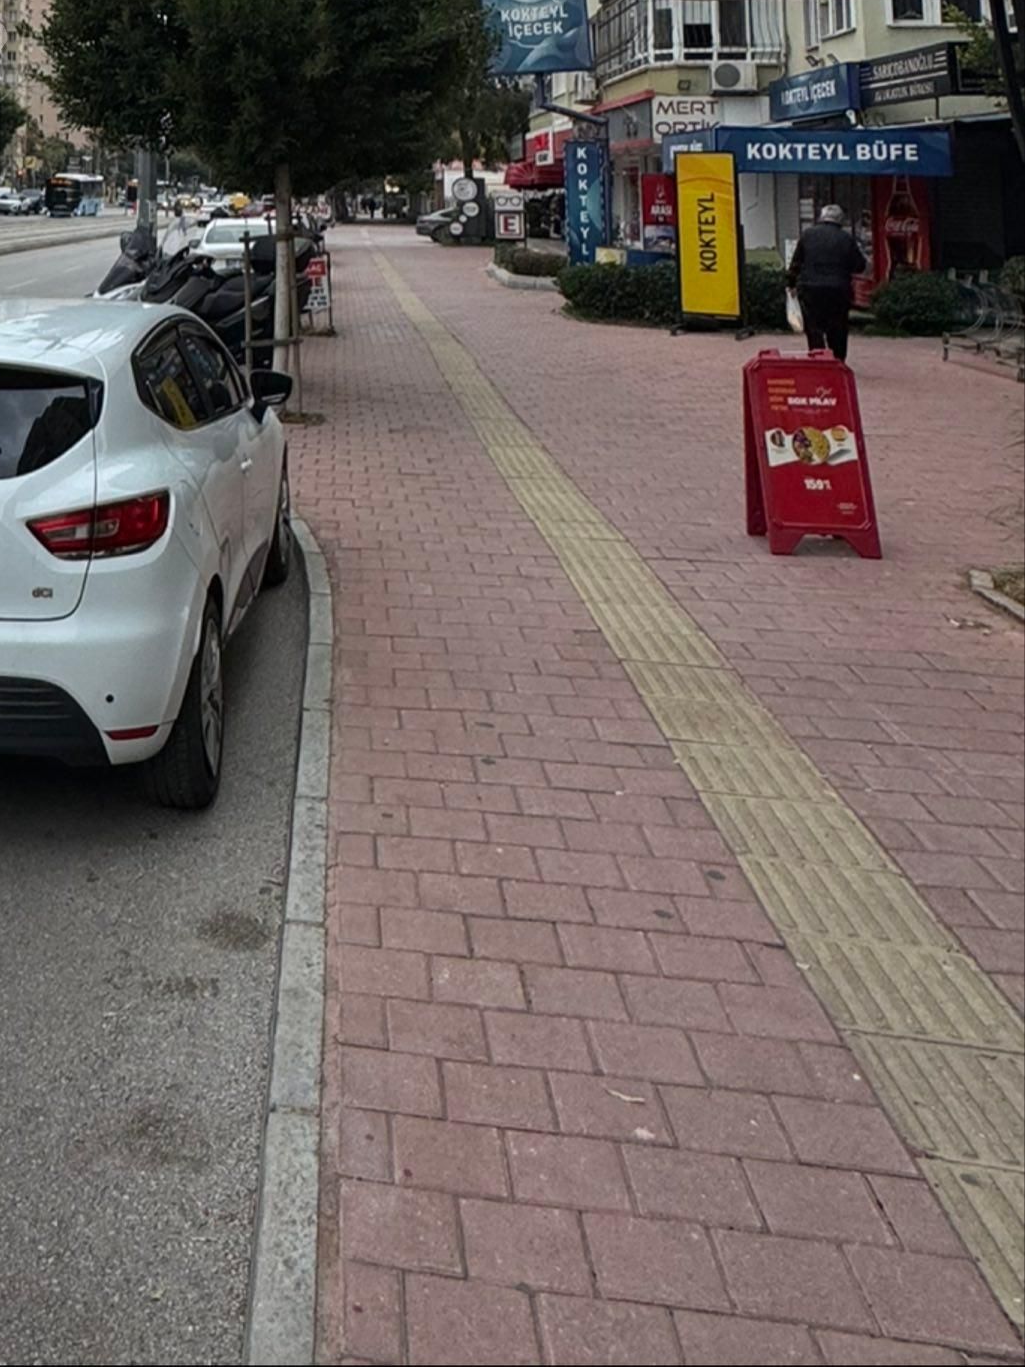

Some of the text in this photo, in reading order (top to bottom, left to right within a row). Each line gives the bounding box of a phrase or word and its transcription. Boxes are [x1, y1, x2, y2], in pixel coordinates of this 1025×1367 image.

[500, 4, 569, 22] KOKTEYL
[508, 21, 564, 40] İÇECEK
[656, 100, 719, 115] MERT
[746, 140, 919, 161] KOKTEYL BÜFE
[576, 146, 589, 256] KOKTEYL
[503, 215, 517, 233] E
[696, 191, 718, 273] KOKTEYL
